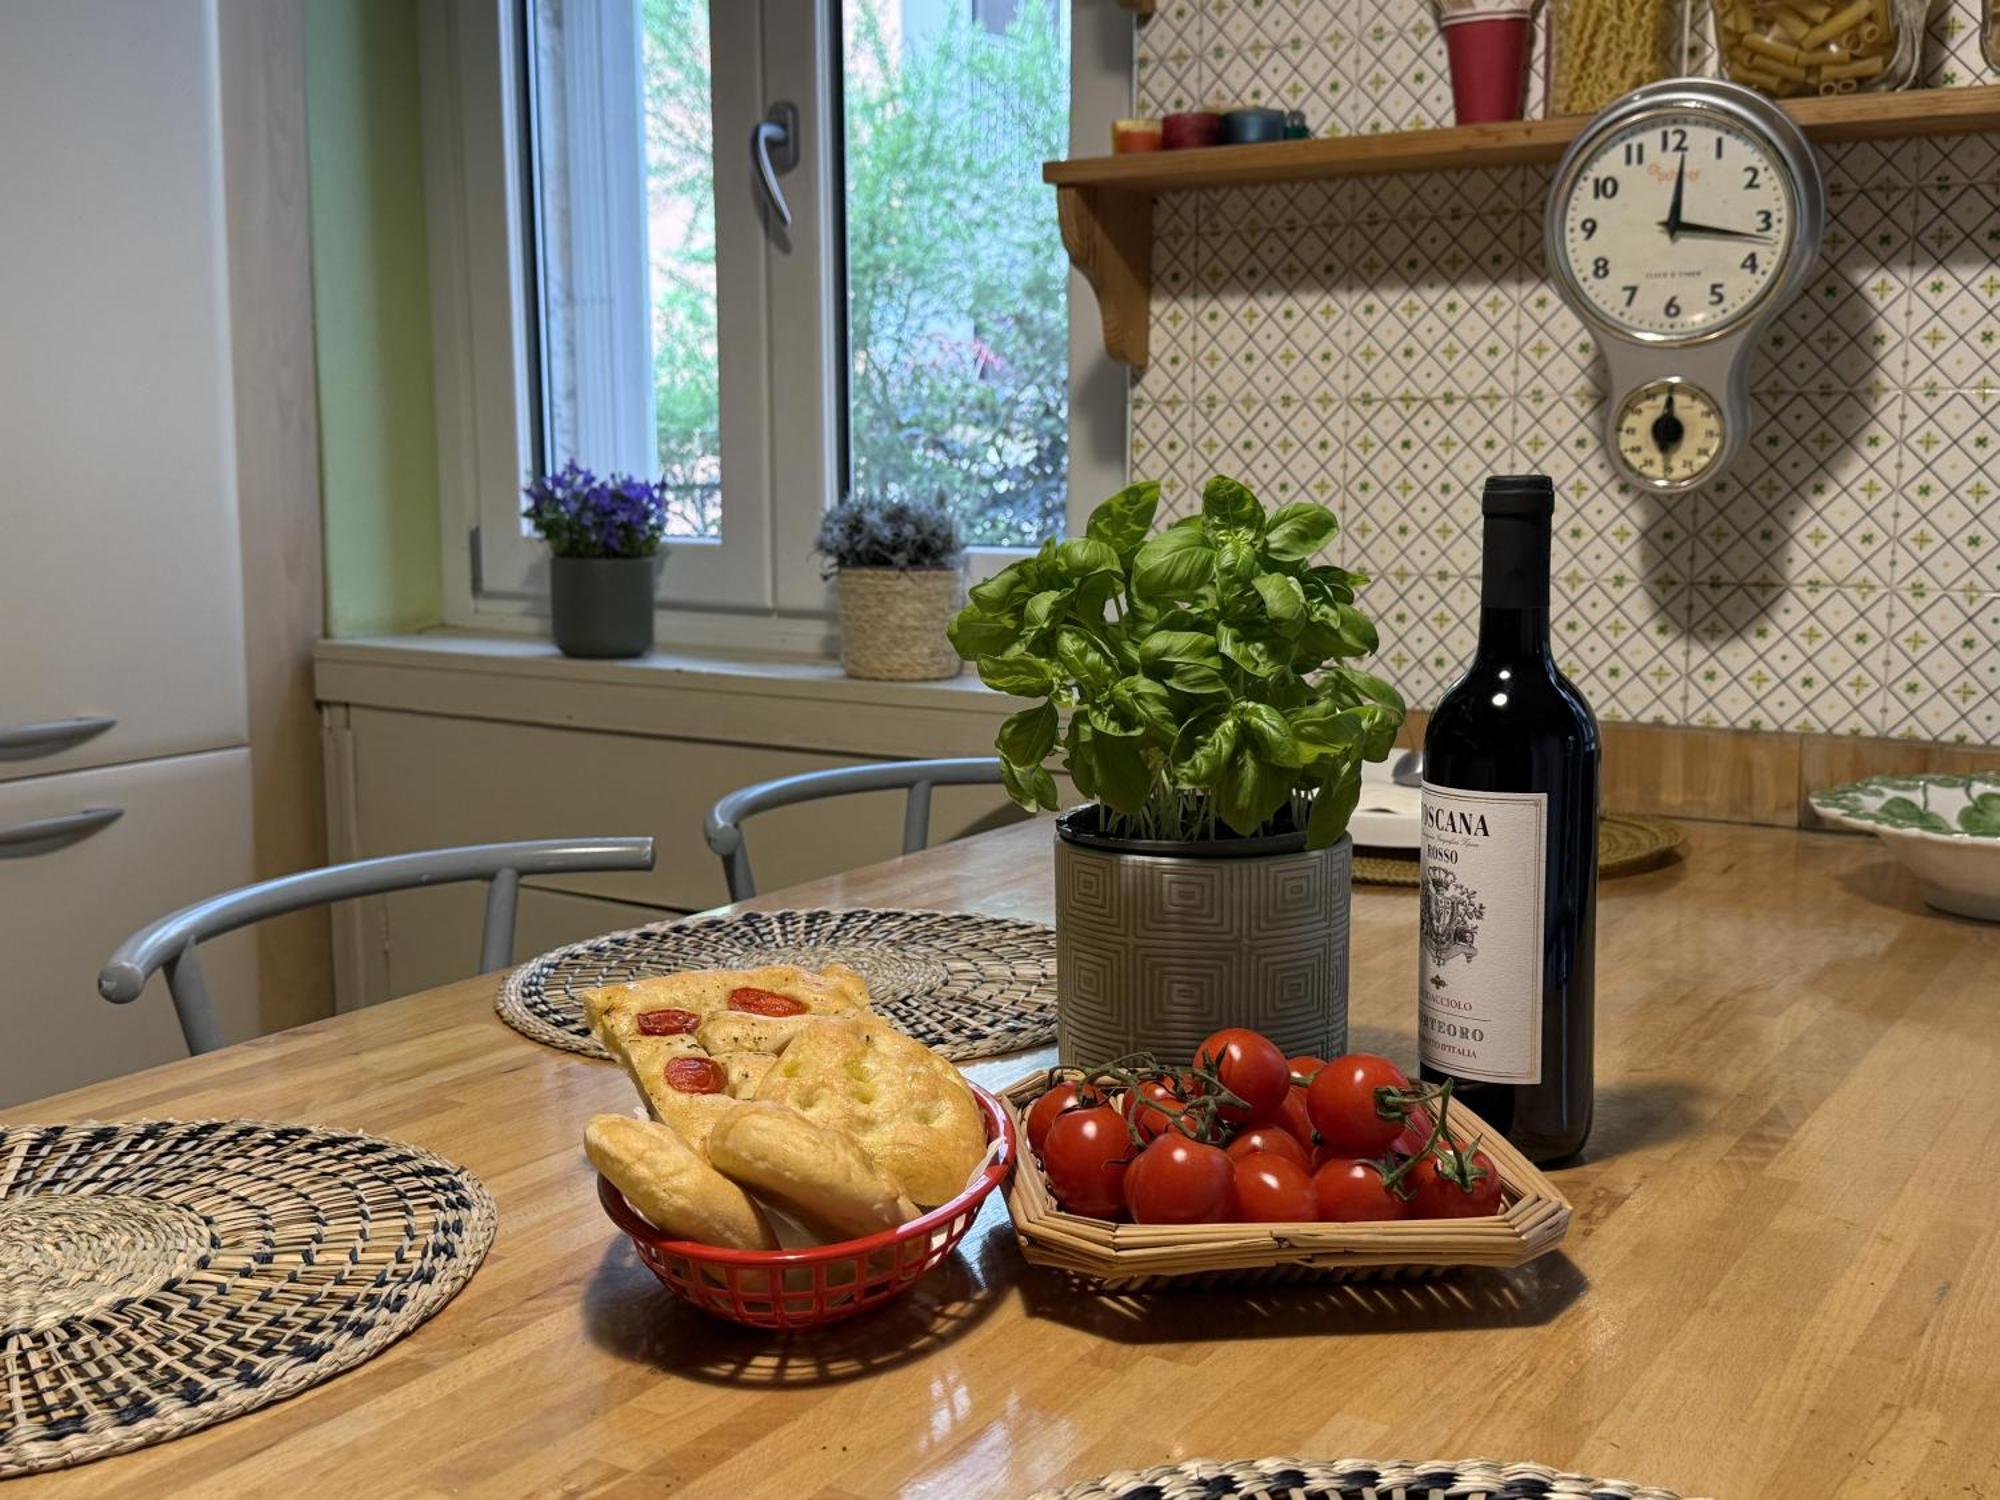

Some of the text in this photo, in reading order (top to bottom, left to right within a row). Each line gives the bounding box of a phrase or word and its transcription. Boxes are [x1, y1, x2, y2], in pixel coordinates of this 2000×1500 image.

[1661, 129, 1689, 153] 12
[1715, 137, 1723, 160] 1
[1624, 143, 1644, 166] 11
[1593, 176, 1619, 199] 10
[1743, 166, 1761, 190] 2
[1580, 217, 1598, 241] 9
[1755, 210, 1773, 233] 3
[1592, 256, 1610, 279] 8
[1740, 252, 1759, 275] 4
[1622, 285, 1639, 308] 7
[1708, 283, 1725, 305] 5
[1663, 296, 1682, 318] 6
[1421, 803, 1490, 837] OSCANA
[1427, 843, 1459, 865] ROSSO
